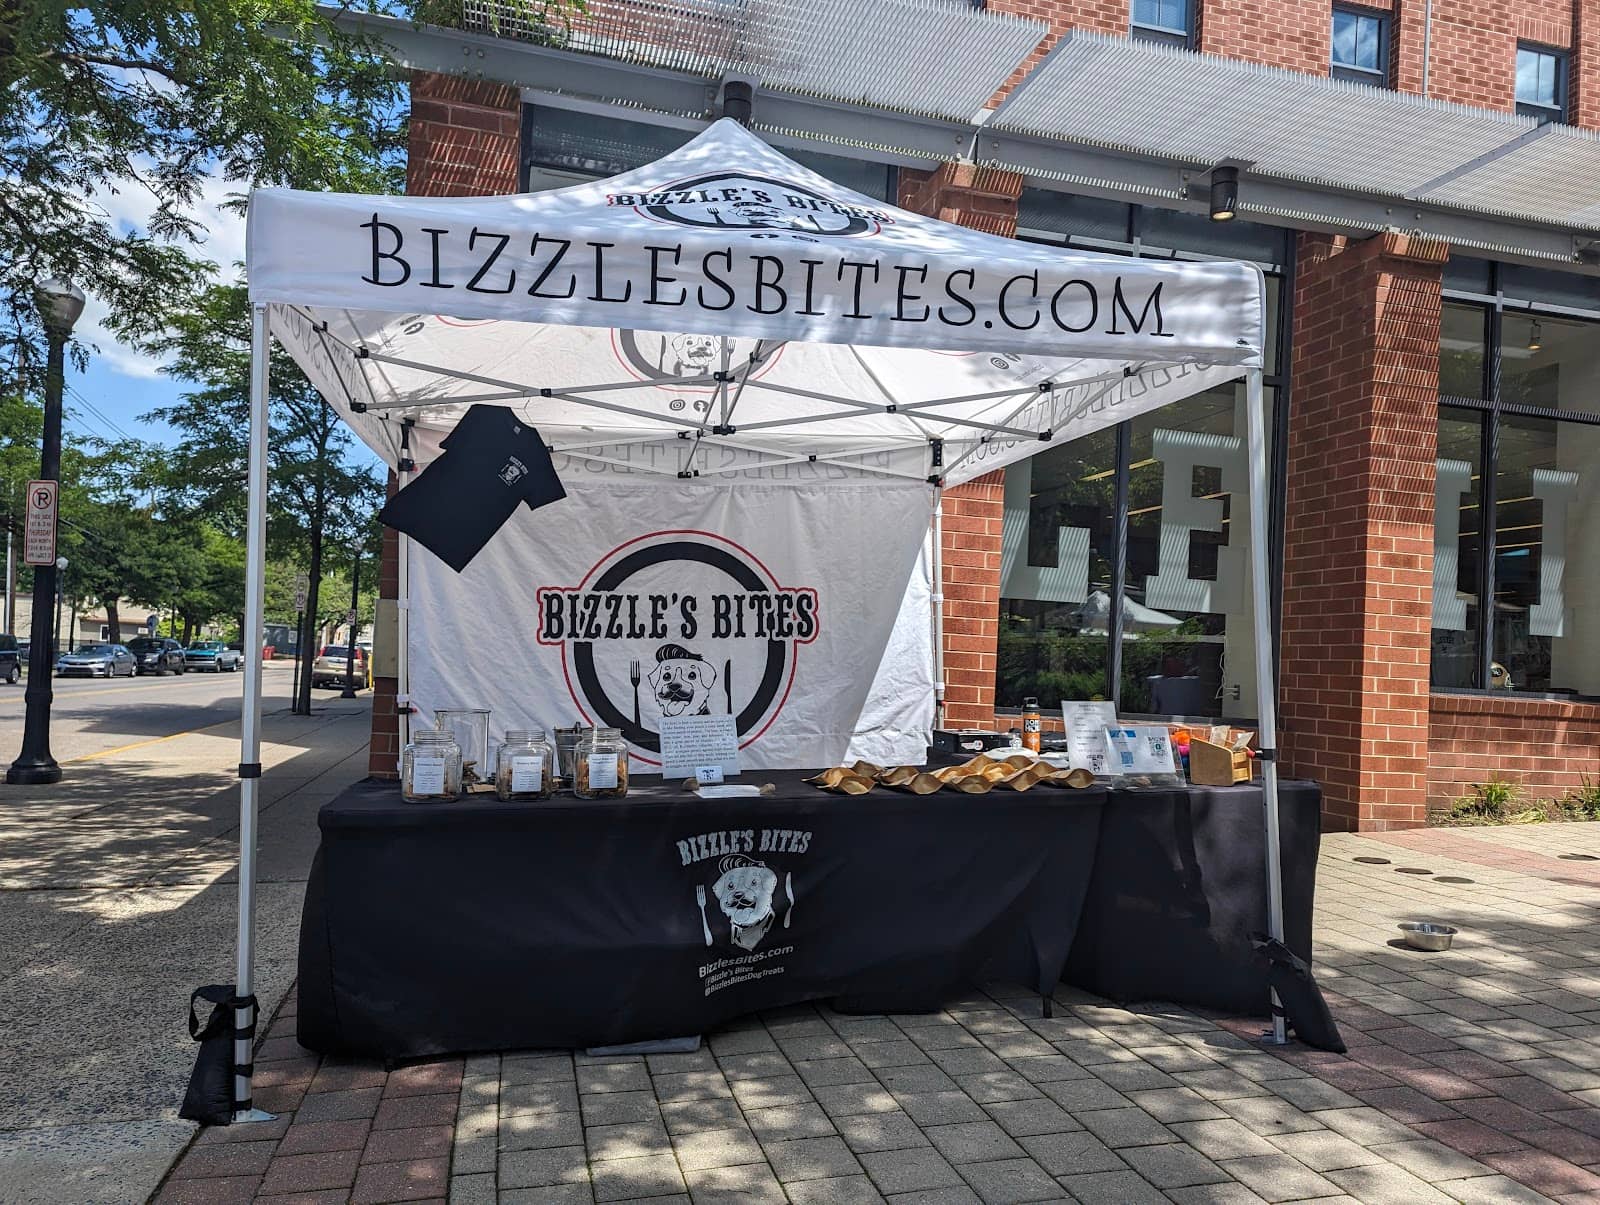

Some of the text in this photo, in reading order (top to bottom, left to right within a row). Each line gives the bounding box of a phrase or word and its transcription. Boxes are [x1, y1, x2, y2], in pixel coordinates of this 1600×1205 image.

[614, 188, 889, 222] BIZZLE'S BITES
[360, 212, 1175, 336] BIZZLESBITES.COM
[542, 593, 814, 639] BIZZLE'S BITES
[676, 829, 812, 866] BIZZLE'S BITES
[699, 945, 794, 978] BizzlesBites.com
